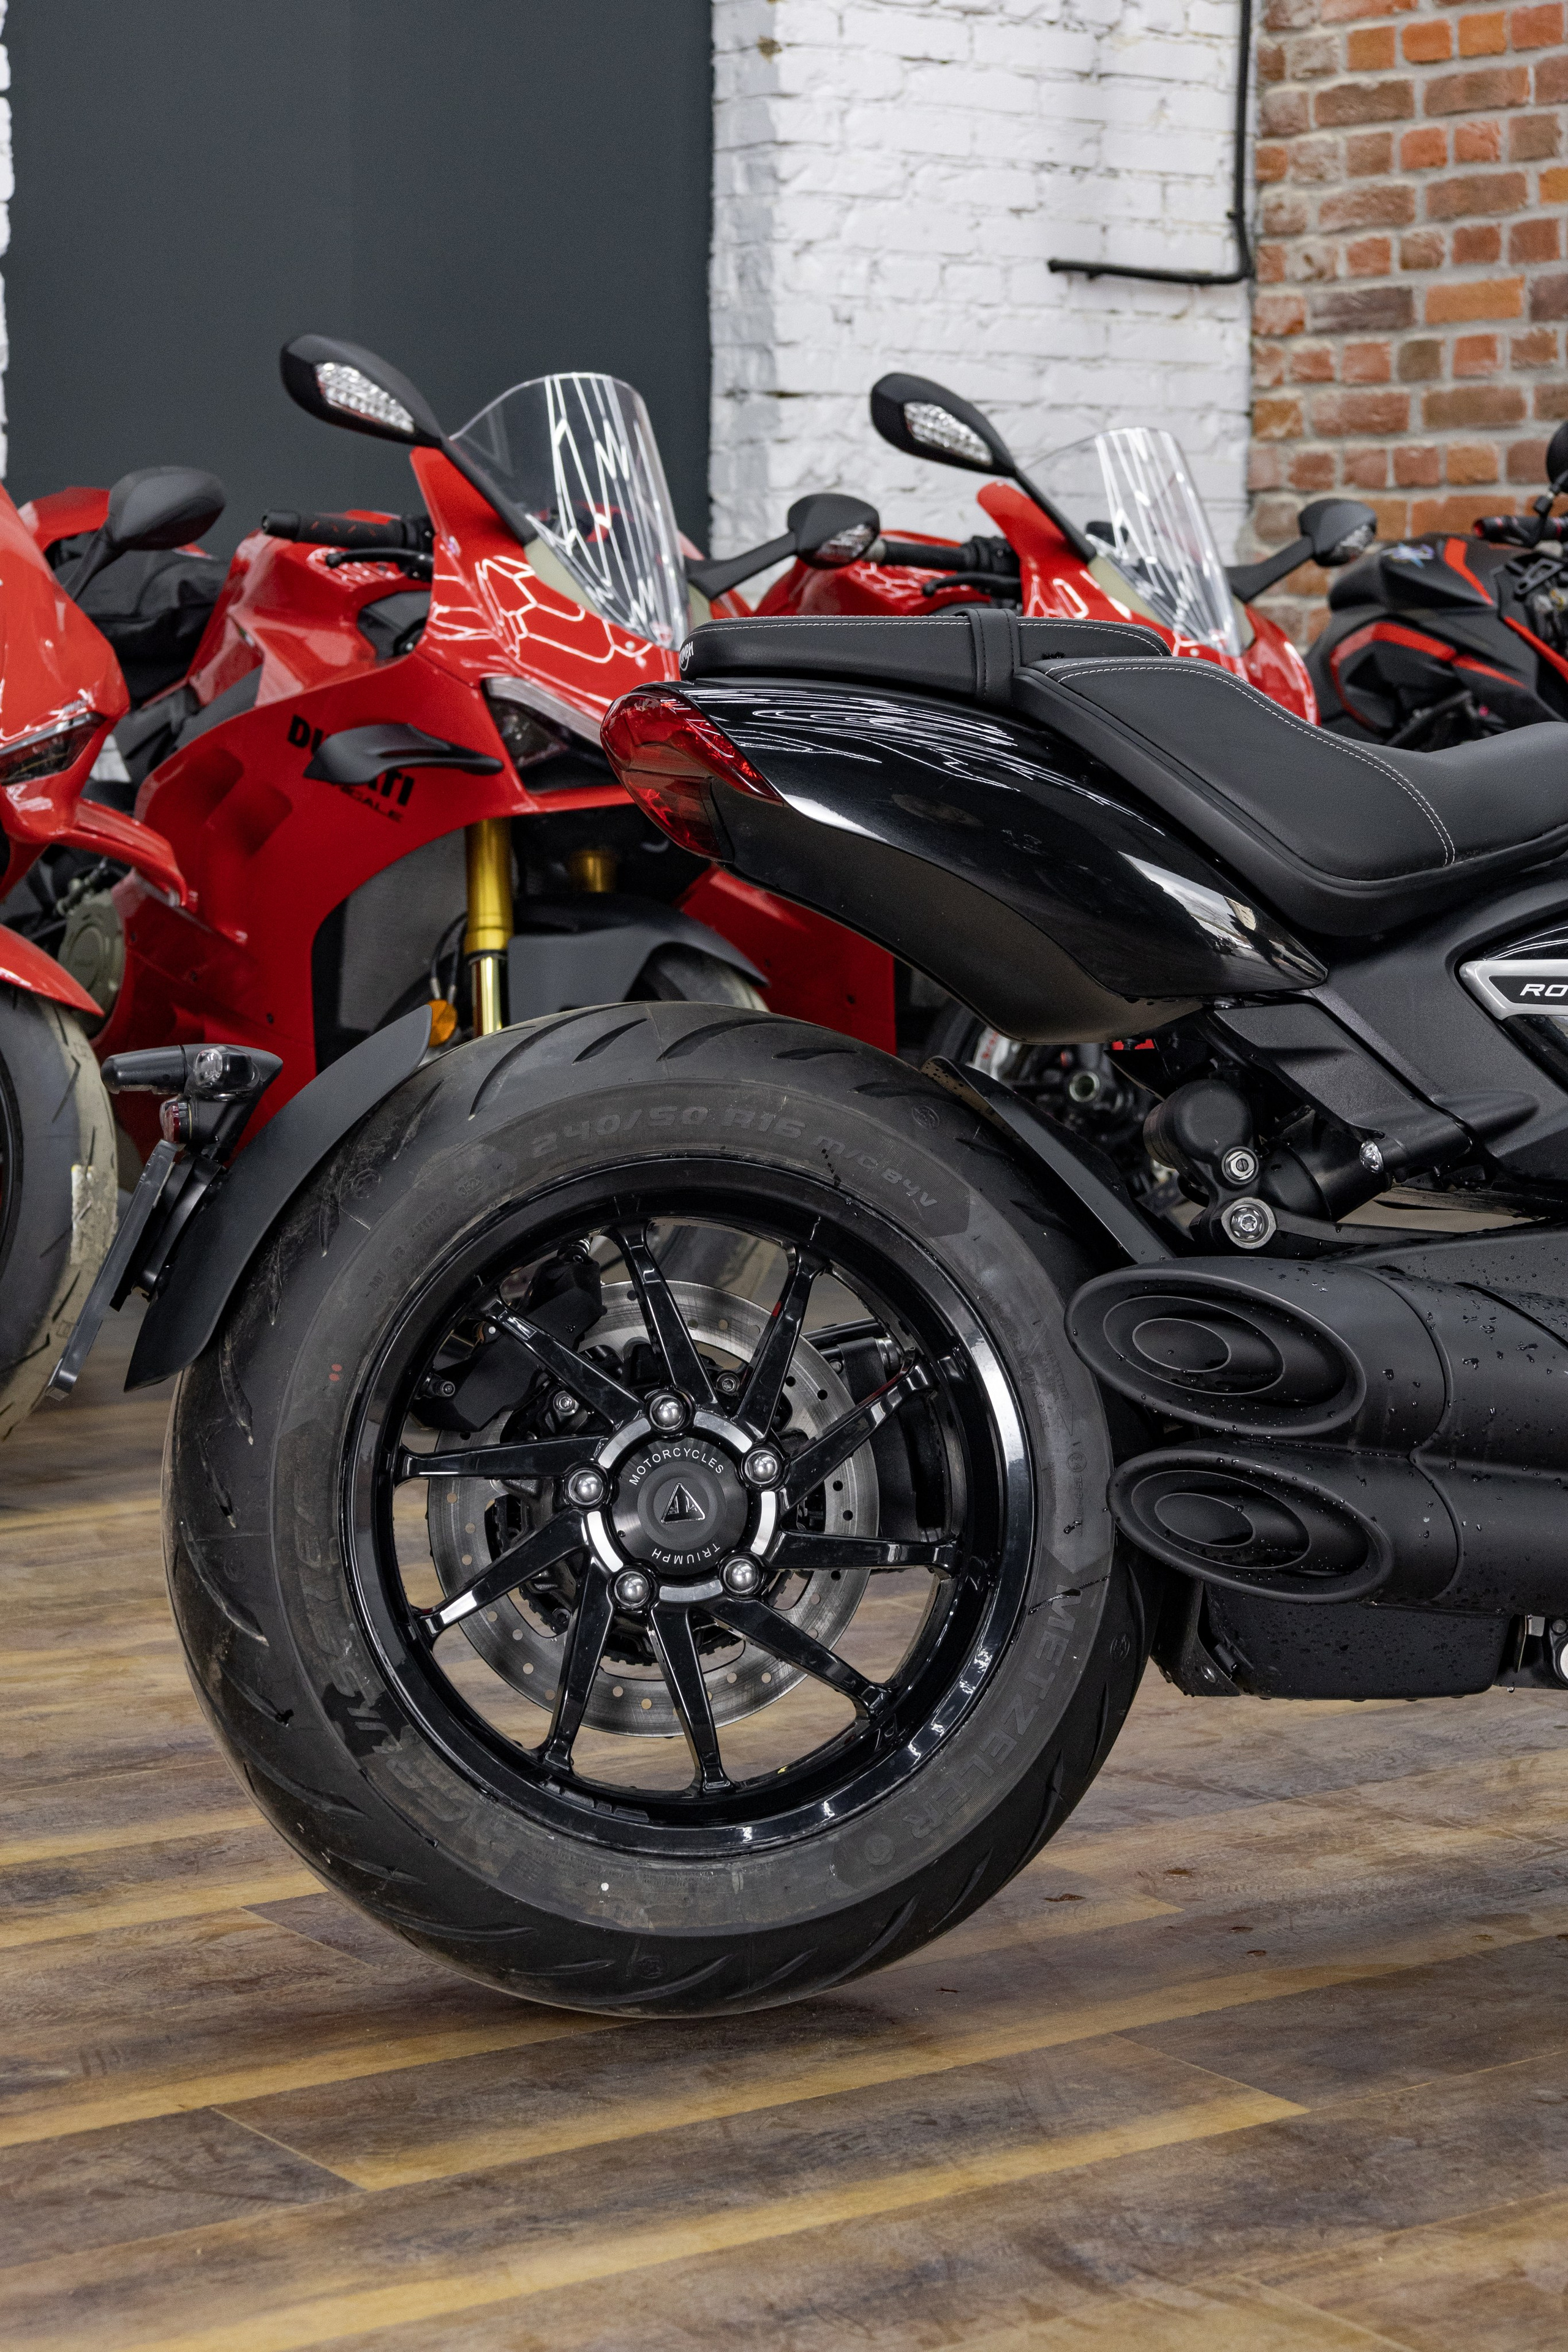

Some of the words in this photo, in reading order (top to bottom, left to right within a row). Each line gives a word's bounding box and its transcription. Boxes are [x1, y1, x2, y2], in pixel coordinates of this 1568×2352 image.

[287, 714, 415, 807] DTI
[530, 1106, 709, 1158] 240/50
[721, 1106, 805, 1140] R16
[628, 1447, 724, 1486] MOTORCYCLES
[651, 1542, 721, 1564] TRIUMPH
[902, 1584, 1083, 1839] METZELER
